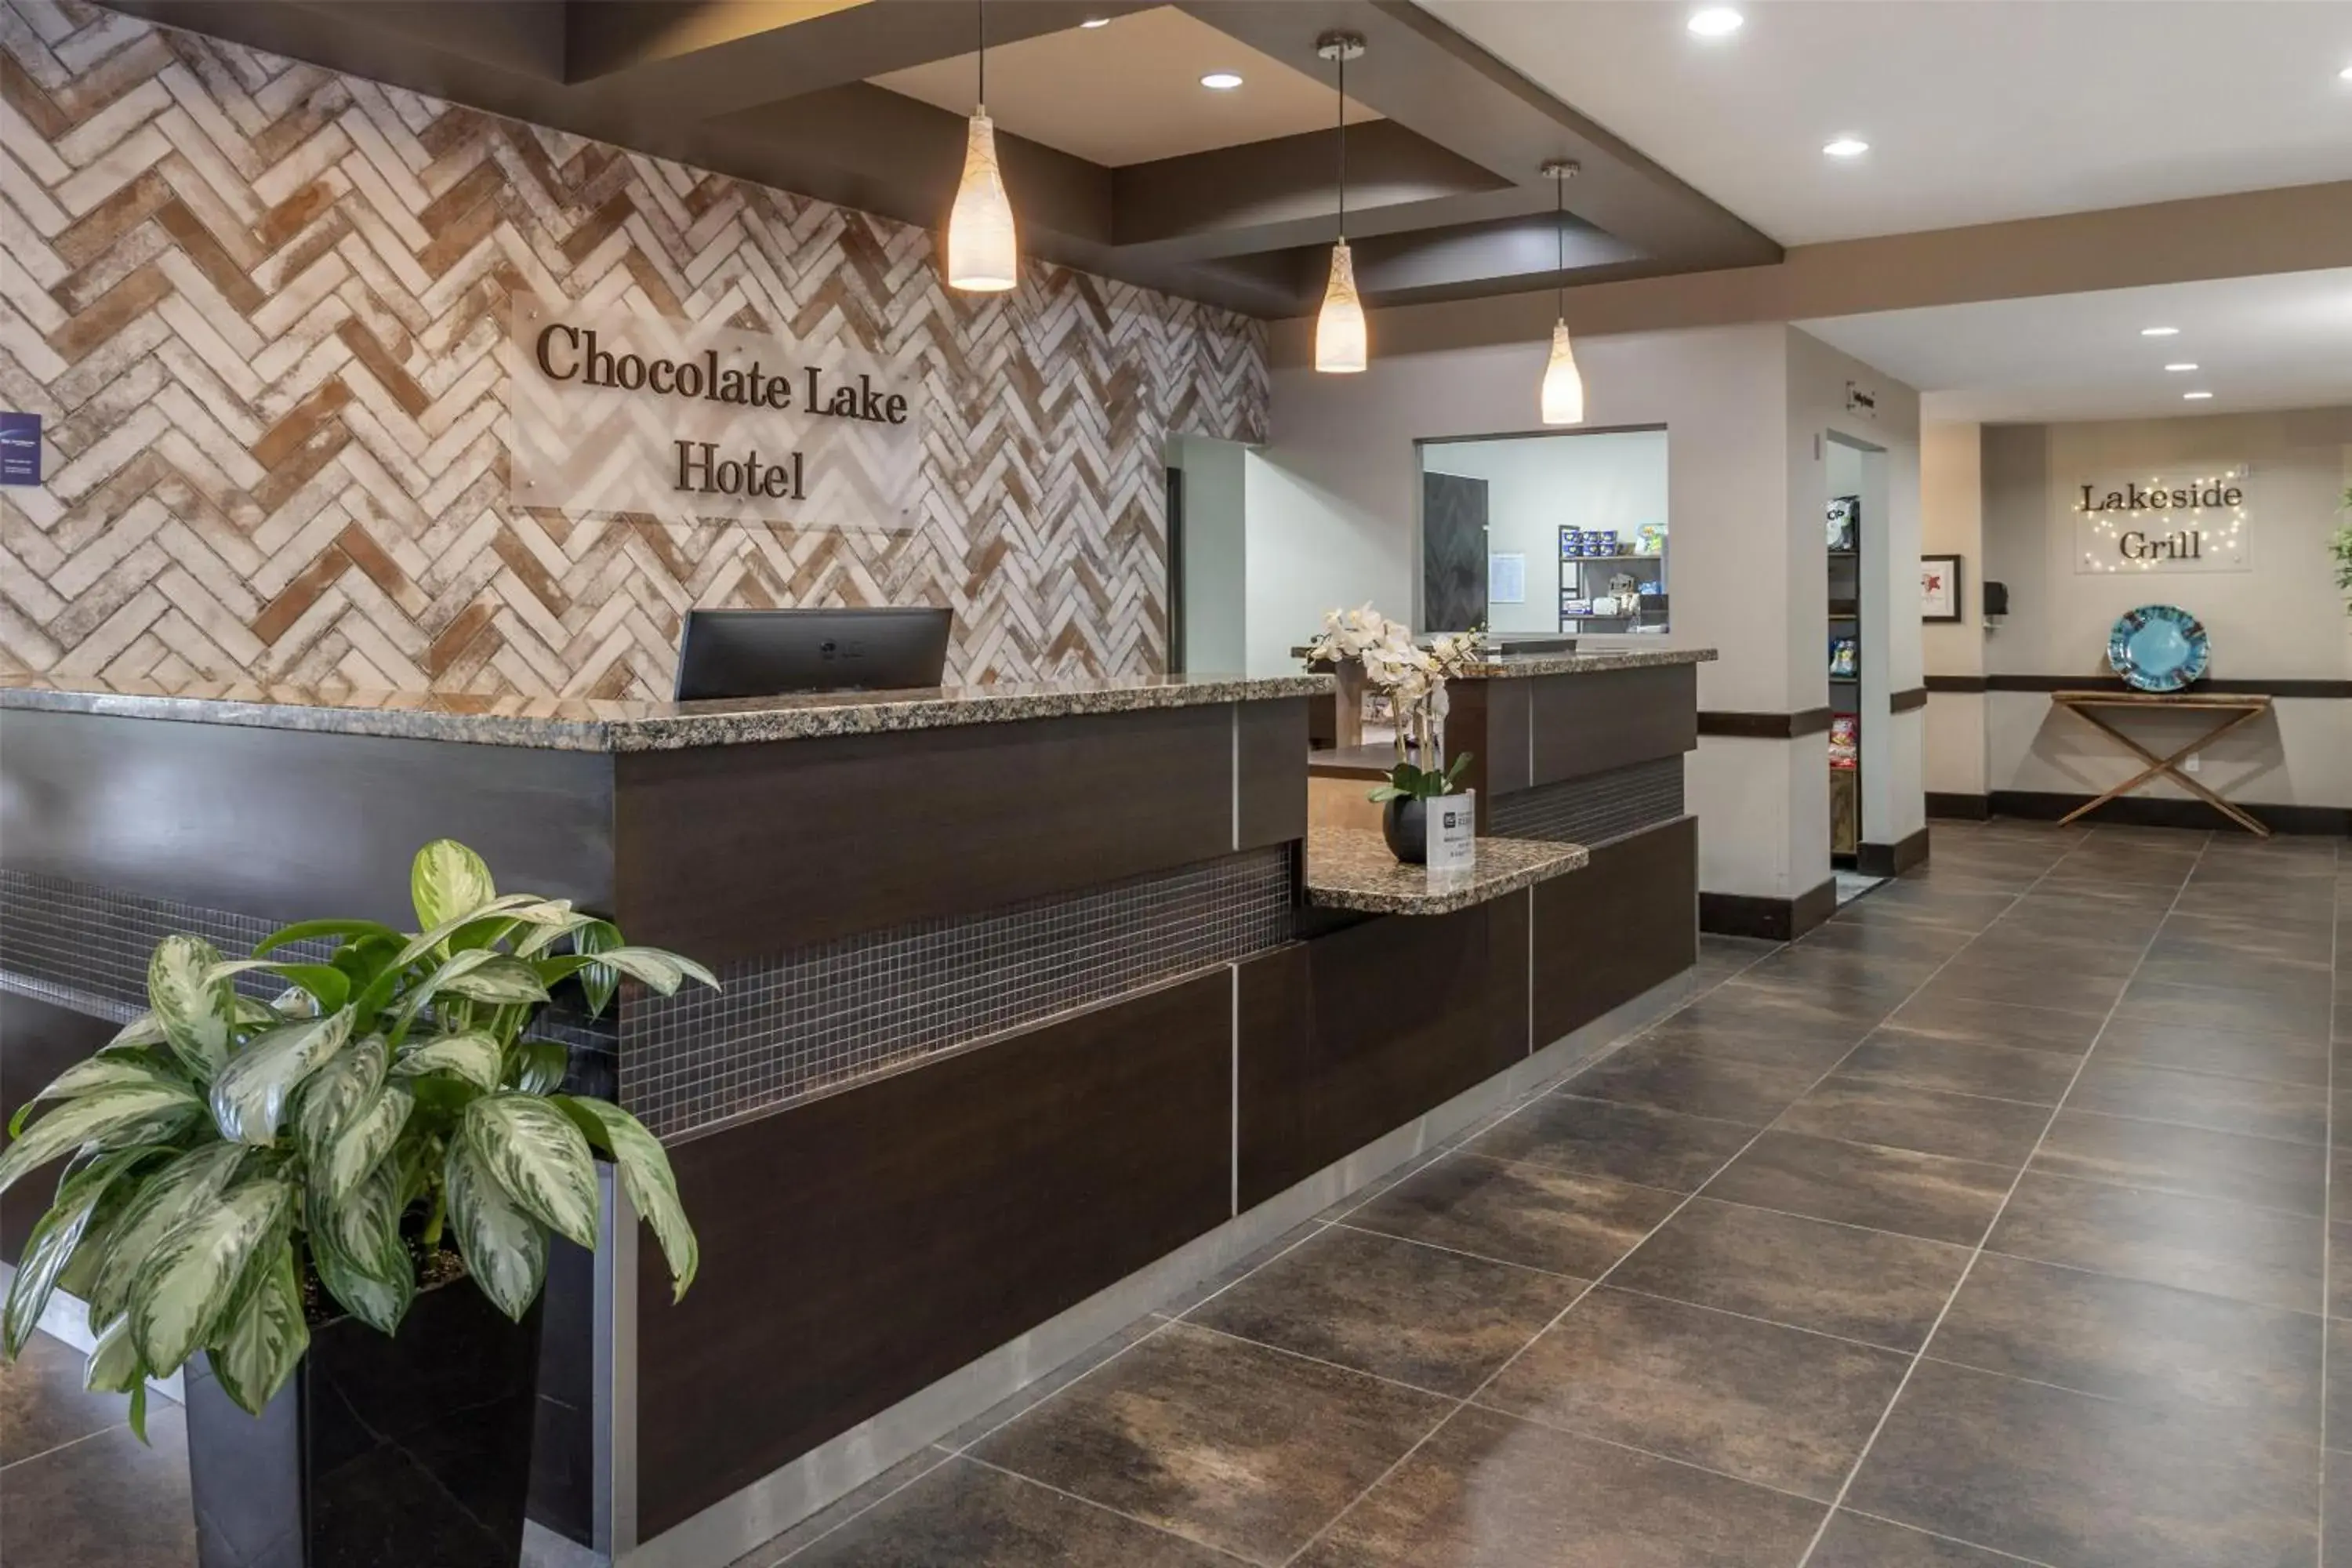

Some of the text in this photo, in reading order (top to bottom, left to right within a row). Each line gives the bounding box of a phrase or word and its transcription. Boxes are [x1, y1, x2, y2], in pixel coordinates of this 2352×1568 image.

[536, 323, 908, 424] Chocolate Lake
[673, 440, 806, 499] Hotel
[2081, 480, 2243, 511] Lakeside
[2119, 531, 2201, 559] Grill
